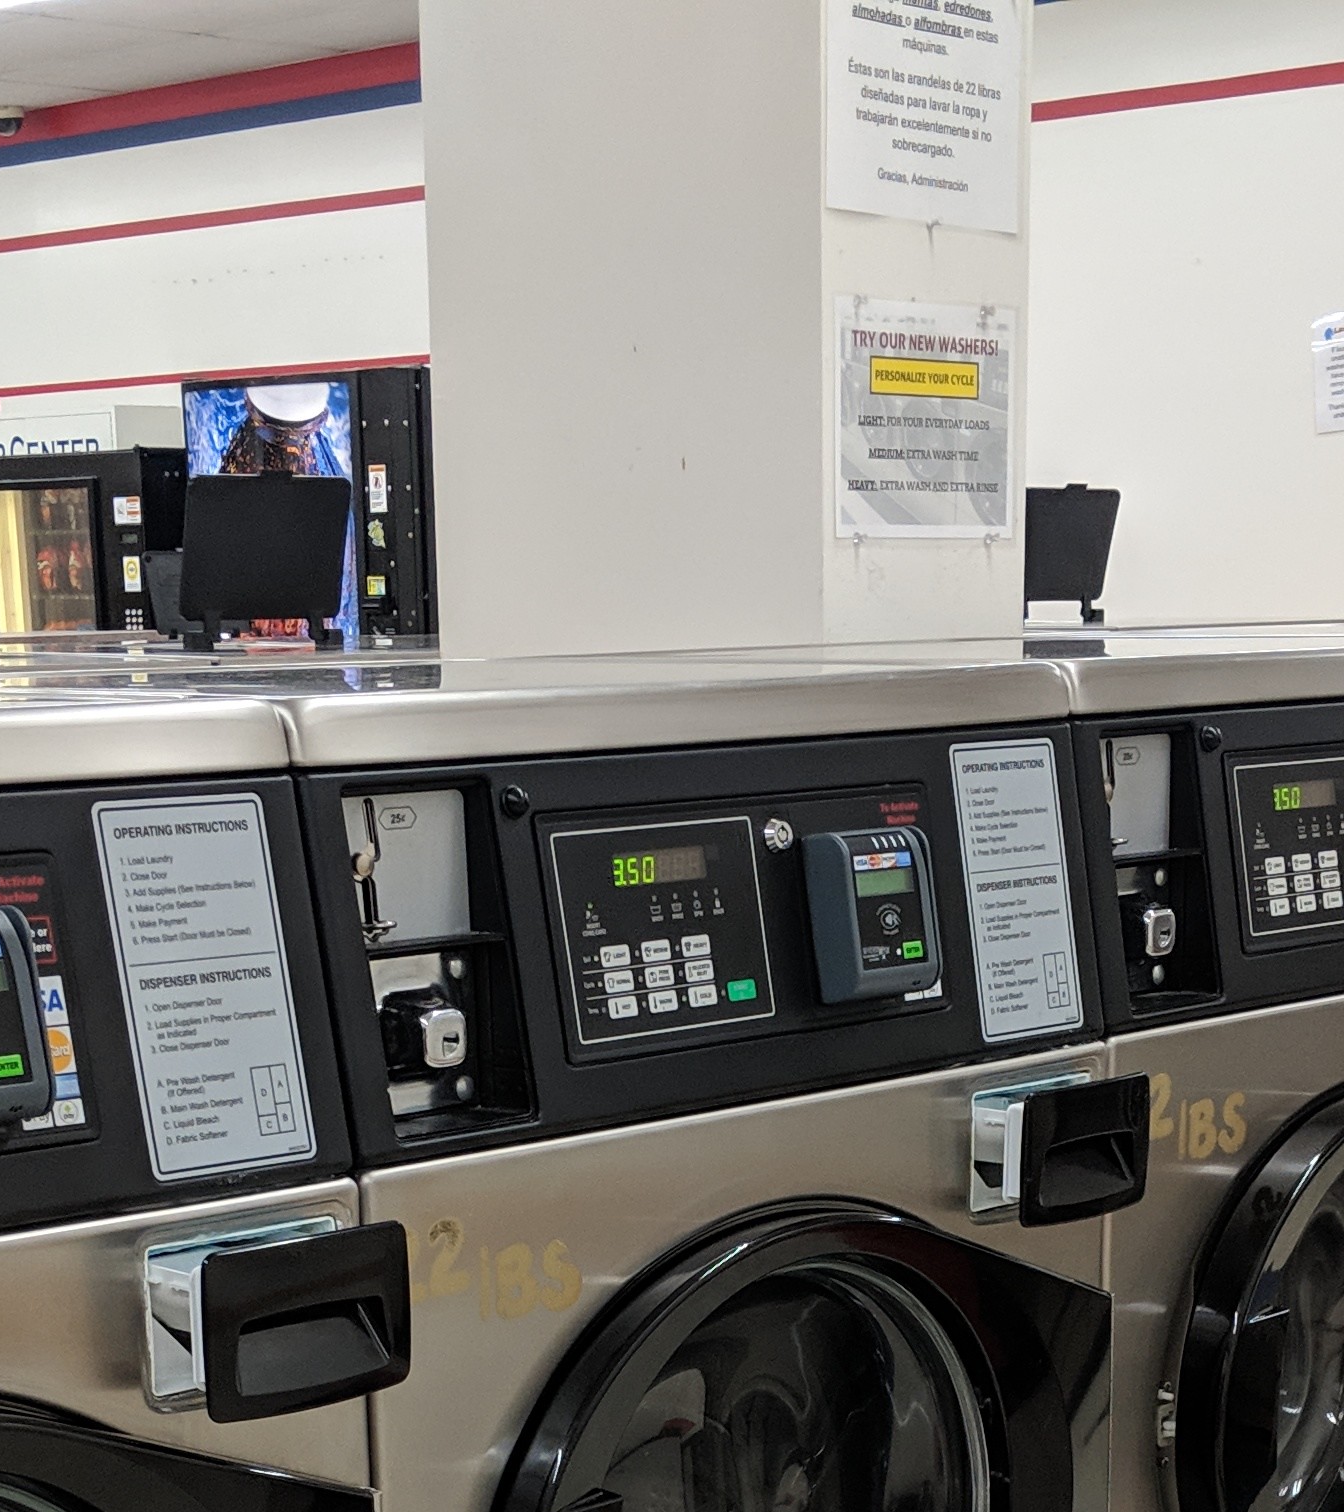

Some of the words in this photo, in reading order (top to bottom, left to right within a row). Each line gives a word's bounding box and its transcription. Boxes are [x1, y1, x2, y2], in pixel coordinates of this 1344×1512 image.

[852, 4, 904, 26] almohadas
[905, 17, 911, 26] o
[914, 17, 963, 38] alfombras
[963, 25, 974, 38] en
[976, 30, 998, 43] estas
[874, 65, 890, 79] son
[892, 67, 904, 82] las
[908, 73, 951, 90] arandelas
[953, 79, 963, 93] de
[965, 82, 976, 96] 22
[978, 85, 1001, 100] libras
[861, 85, 904, 105] diseñadas
[907, 96, 926, 112] para
[929, 98, 950, 112] lavar
[952, 102, 960, 114] la
[962, 105, 980, 119] ropa
[982, 108, 988, 121] y
[856, 107, 898, 127] trabajarán
[901, 115, 969, 138] excelentemente
[972, 127, 979, 140] si
[980, 131, 992, 142] no
[892, 137, 954, 158] sobrecargado.
[877, 167, 909, 185] Gracias,
[911, 173, 968, 192] Administración
[852, 330, 876, 347] TRY
[879, 332, 906, 350] OUR
[909, 334, 935, 351] NEW
[938, 336, 999, 357] WASHERS!
[875, 370, 926, 384] PERSONALIZE
[928, 372, 949, 385] YOUR
[951, 374, 974, 386] CYCLE
[858, 415, 886, 427] LIGHT:
[887, 416, 902, 427] FOR
[903, 416, 924, 428] YOUR
[925, 418, 964, 429] EVERYDAY
[965, 419, 989, 430] LOADS
[869, 448, 905, 460] MEDIUM:
[906, 450, 932, 460] EXTRA
[933, 450, 957, 461] WASH
[958, 451, 979, 461] TIME
[848, 480, 878, 491] HEAVY:
[880, 481, 904, 491] EXTRA
[906, 482, 931, 492] WASH
[932, 482, 949, 492] AND
[950, 482, 975, 492] EXTRA
[976, 482, 999, 493] RINSE
[962, 763, 998, 773] OPERATING
[1000, 759, 1044, 770] INSTRUCTIONS
[114, 824, 172, 839] OPERATING
[176, 820, 248, 835] INSTRUCTIONS
[613, 855, 654, 887] 3.50
[977, 880, 1011, 892] DISPENSER
[1013, 875, 1057, 888] INSTRUCTIONS
[140, 974, 197, 990] DISPENSER
[200, 967, 272, 983] INSTRUCTIONS
[261, 1089, 267, 1097] D
[266, 1120, 272, 1128] C
[283, 1113, 288, 1121] B
